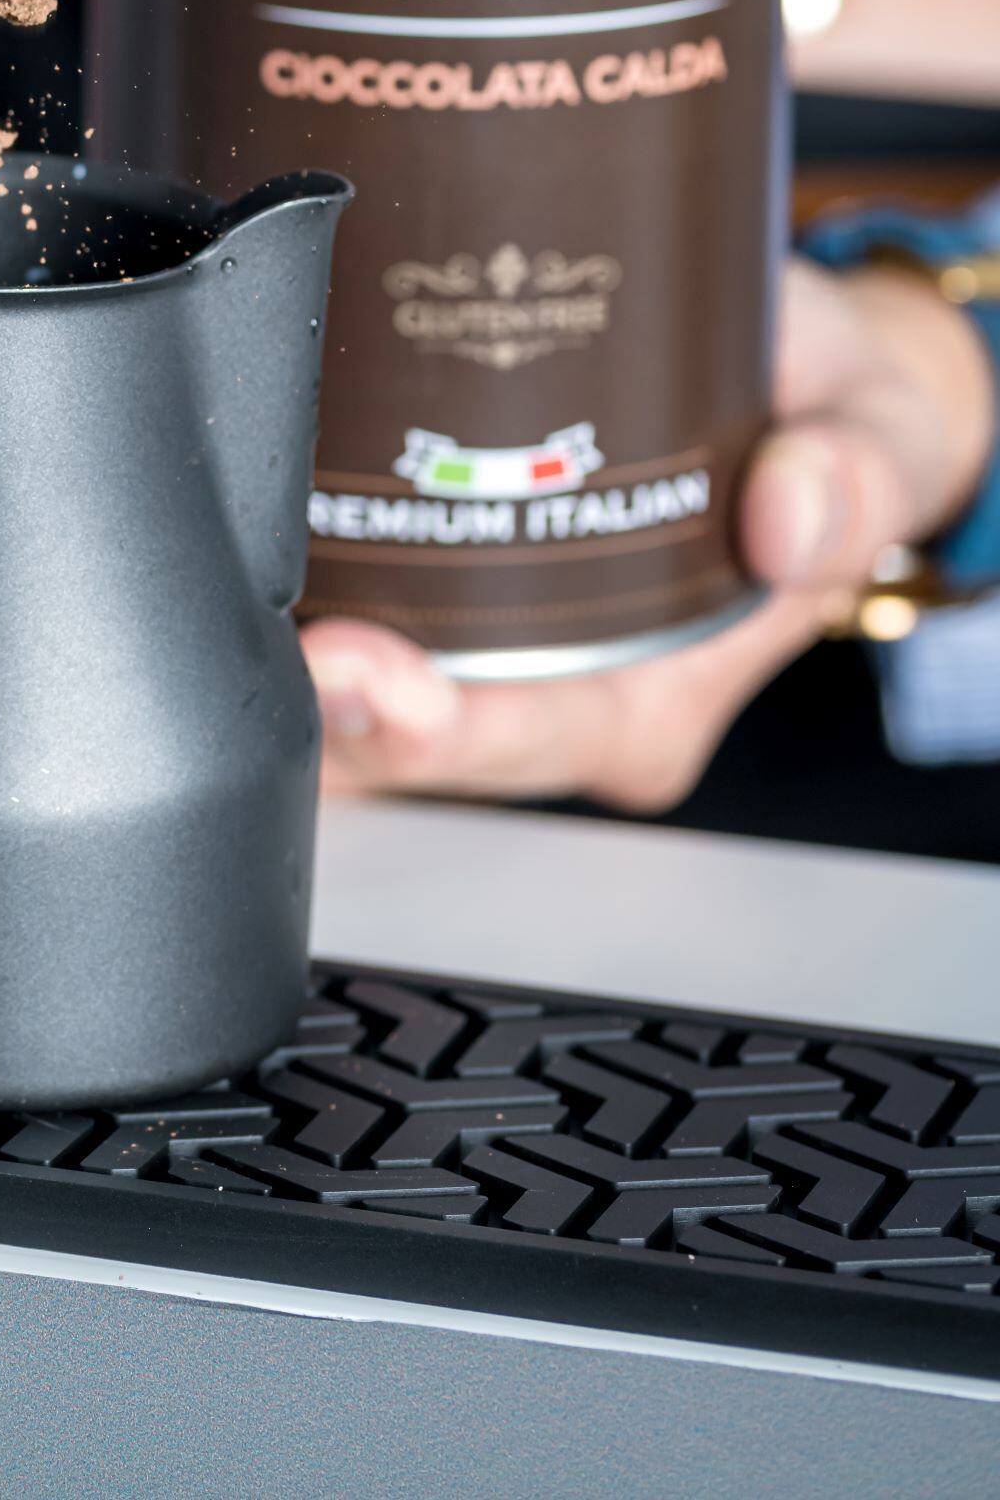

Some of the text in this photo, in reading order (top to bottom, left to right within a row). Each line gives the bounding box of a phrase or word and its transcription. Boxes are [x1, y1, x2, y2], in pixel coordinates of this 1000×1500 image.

[260, 37, 727, 111] CIOCCOLATA CALDA
[307, 469, 711, 544] REMIUM ITALIAN
